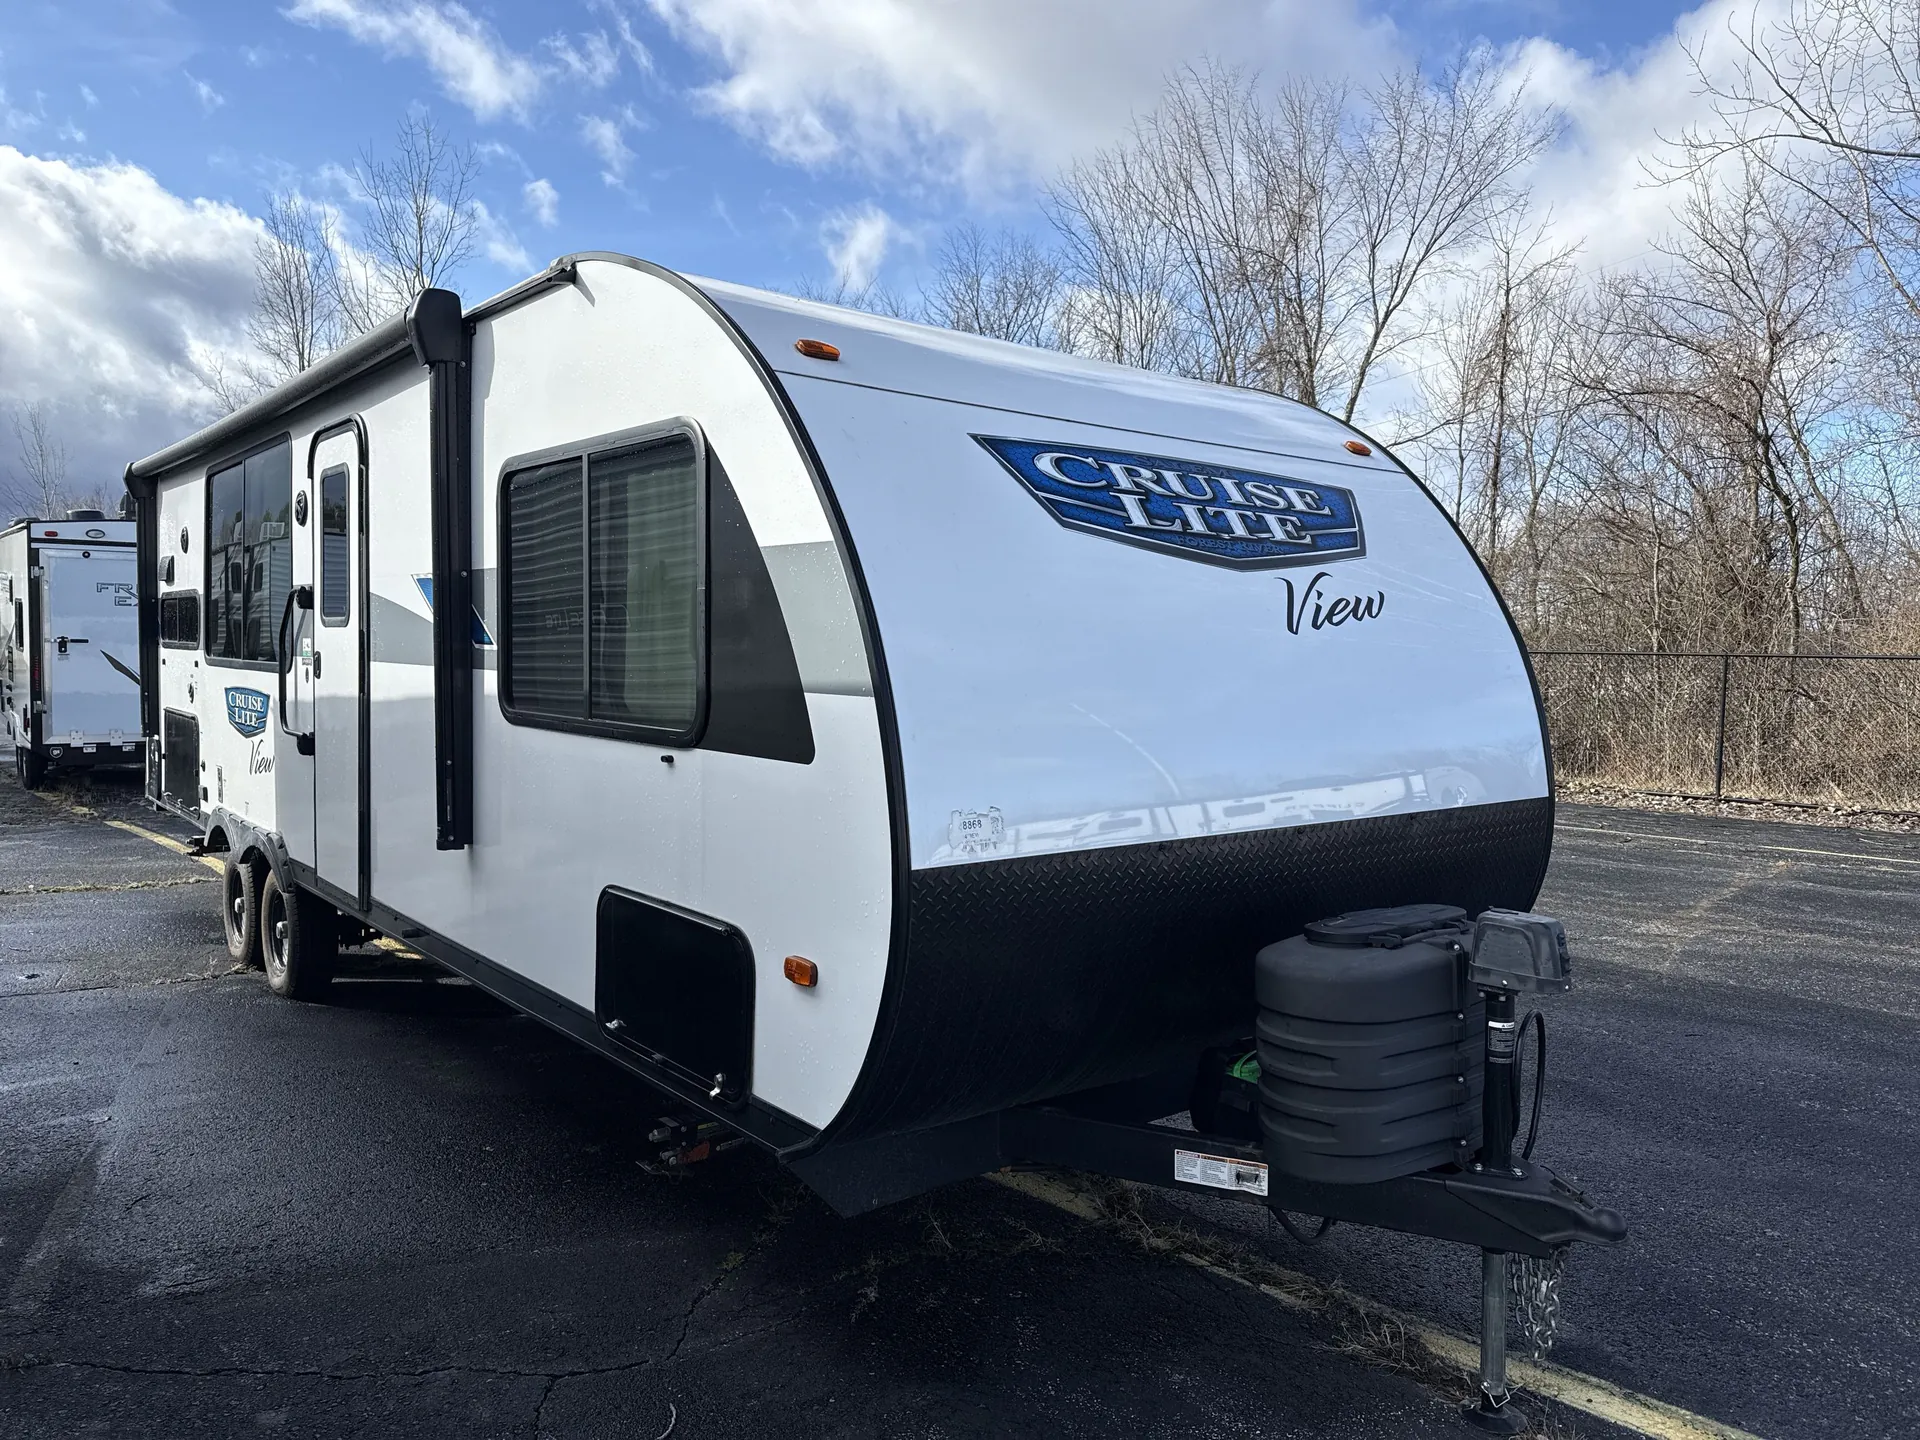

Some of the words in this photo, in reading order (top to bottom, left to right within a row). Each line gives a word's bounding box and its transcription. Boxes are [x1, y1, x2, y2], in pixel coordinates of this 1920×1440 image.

[1033, 452, 1331, 516] CRUISE
[1109, 492, 1313, 545] LITE
[1175, 534, 1235, 550] FOREST
[1238, 541, 1284, 555] RIVER
[1273, 571, 1385, 635] View
[228, 691, 264, 712] CRUISE
[234, 707, 259, 727] LITE
[249, 739, 275, 775] View
[962, 819, 983, 830] 8868
